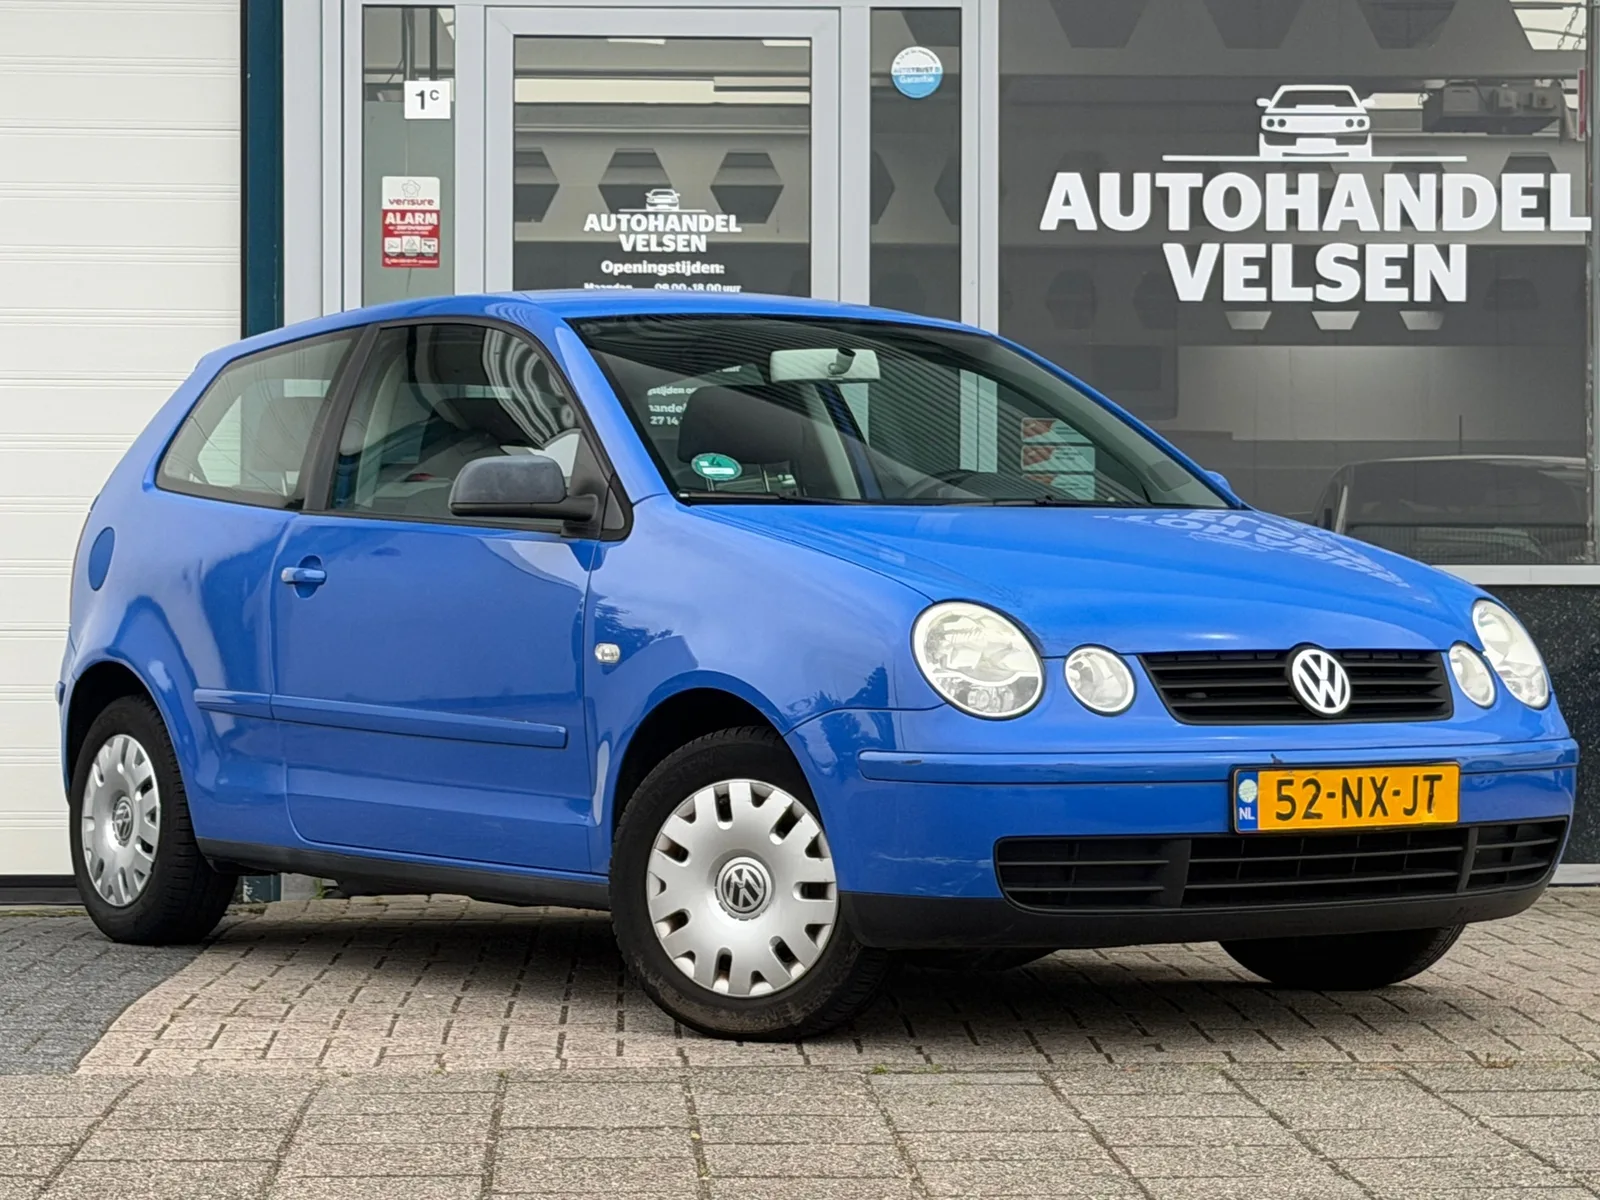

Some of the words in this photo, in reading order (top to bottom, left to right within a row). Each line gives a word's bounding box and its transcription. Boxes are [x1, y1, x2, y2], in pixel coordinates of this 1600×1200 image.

[388, 198, 434, 206] verisure
[1039, 171, 1592, 232] AUTOHANDEL
[384, 212, 438, 225] ALARM
[583, 213, 742, 233] AUTOHANDEL
[618, 233, 707, 253] VELSEN
[600, 260, 725, 277] Openingstijden:
[1162, 242, 1467, 303] VELSEN
[1275, 774, 1443, 822] 52-NX-JT
[1238, 806, 1256, 821] NL
